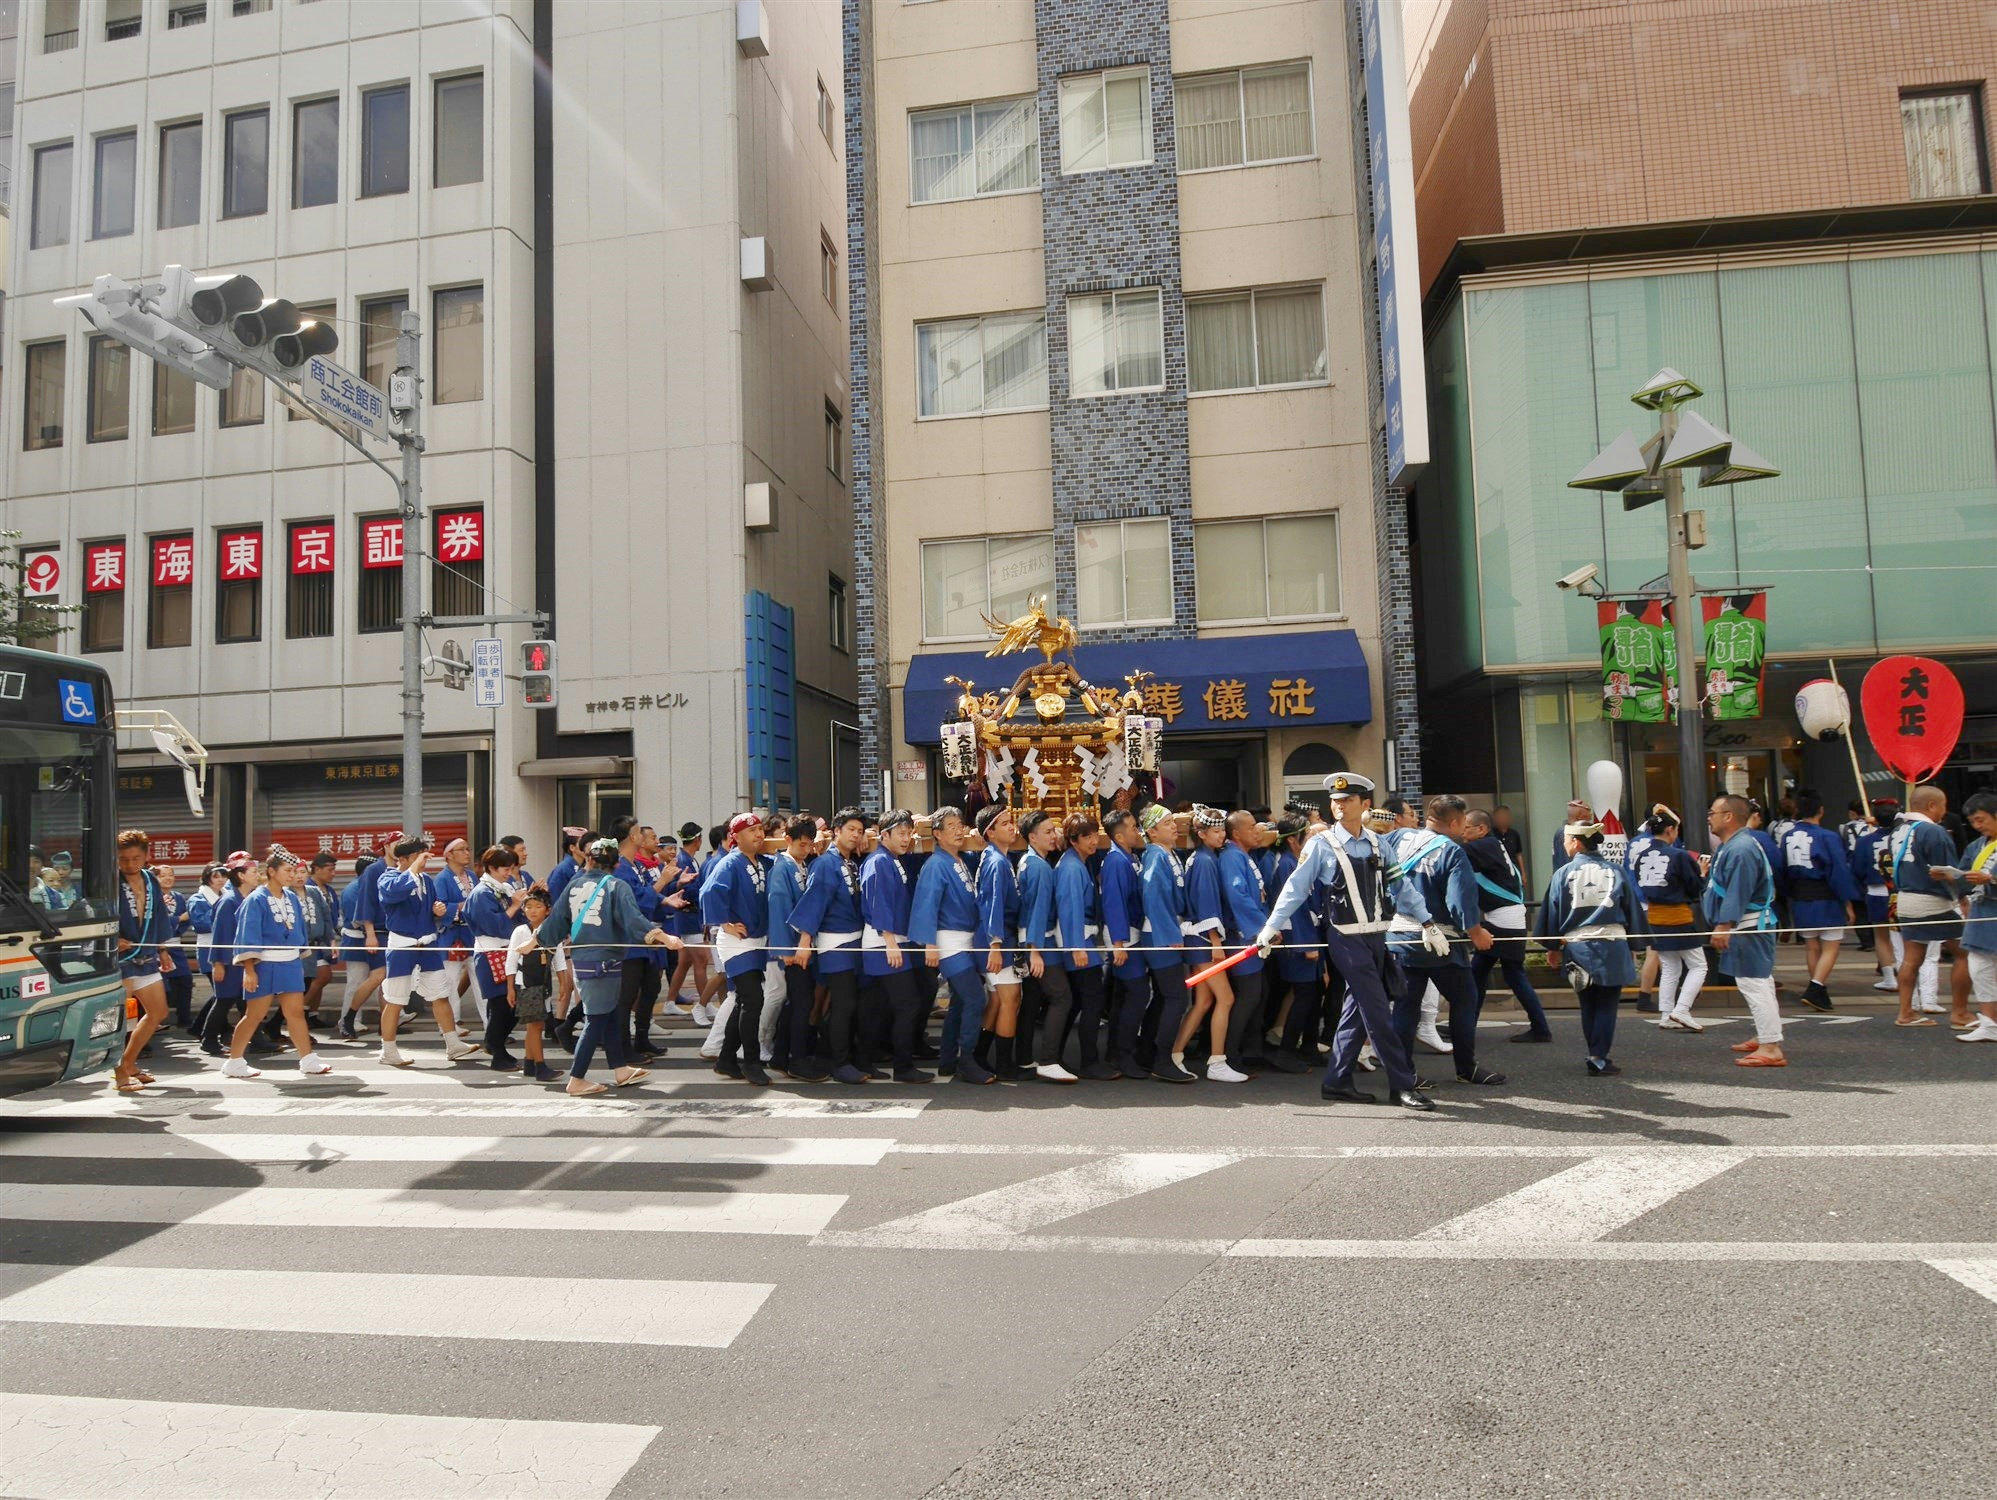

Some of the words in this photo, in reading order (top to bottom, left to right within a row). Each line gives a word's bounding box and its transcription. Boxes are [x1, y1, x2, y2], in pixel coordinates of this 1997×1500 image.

[311, 358, 383, 418] 商工会館前
[320, 388, 374, 428] Shokokaikan
[477, 645, 488, 678] 自転車
[489, 645, 500, 678] 歩行者
[484, 680, 495, 702] 専用
[1898, 666, 1930, 737] 大正
[1127, 726, 1142, 768] 大正祭礼
[325, 764, 400, 780] 東海東京証券
[149, 839, 190, 860] 証券
